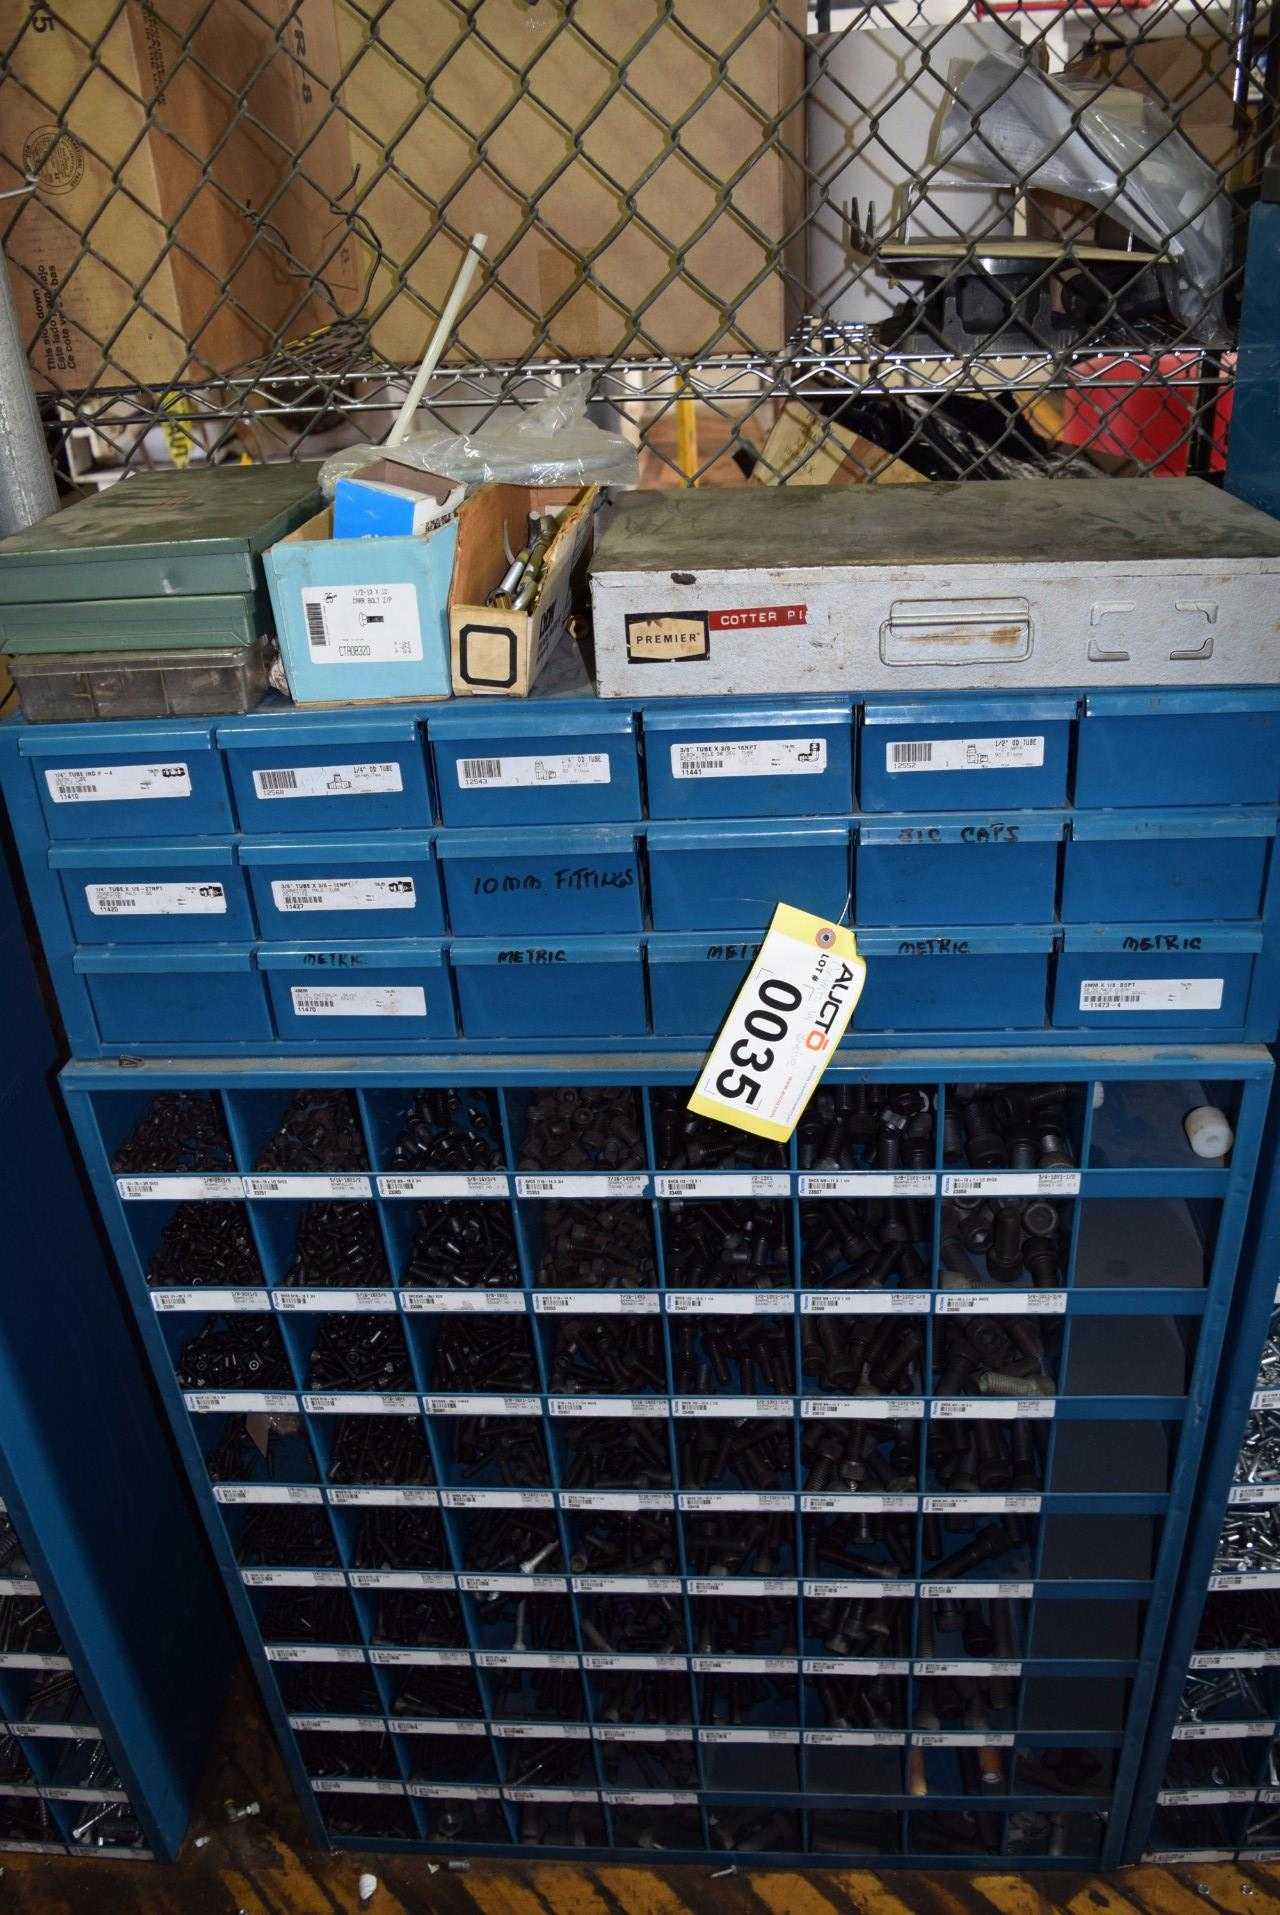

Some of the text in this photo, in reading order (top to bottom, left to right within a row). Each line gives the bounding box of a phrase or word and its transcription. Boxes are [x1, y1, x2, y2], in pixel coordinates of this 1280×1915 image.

[31, 288, 45, 320] down
[720, 611, 777, 626] COTTER
[636, 633, 698, 645] PREMIER
[898, 939, 971, 956] METRIC
[1122, 934, 1203, 953] METRIC
[498, 949, 568, 964] METRIC
[814, 952, 830, 974] LOT
[715, 978, 803, 1106] 0035
